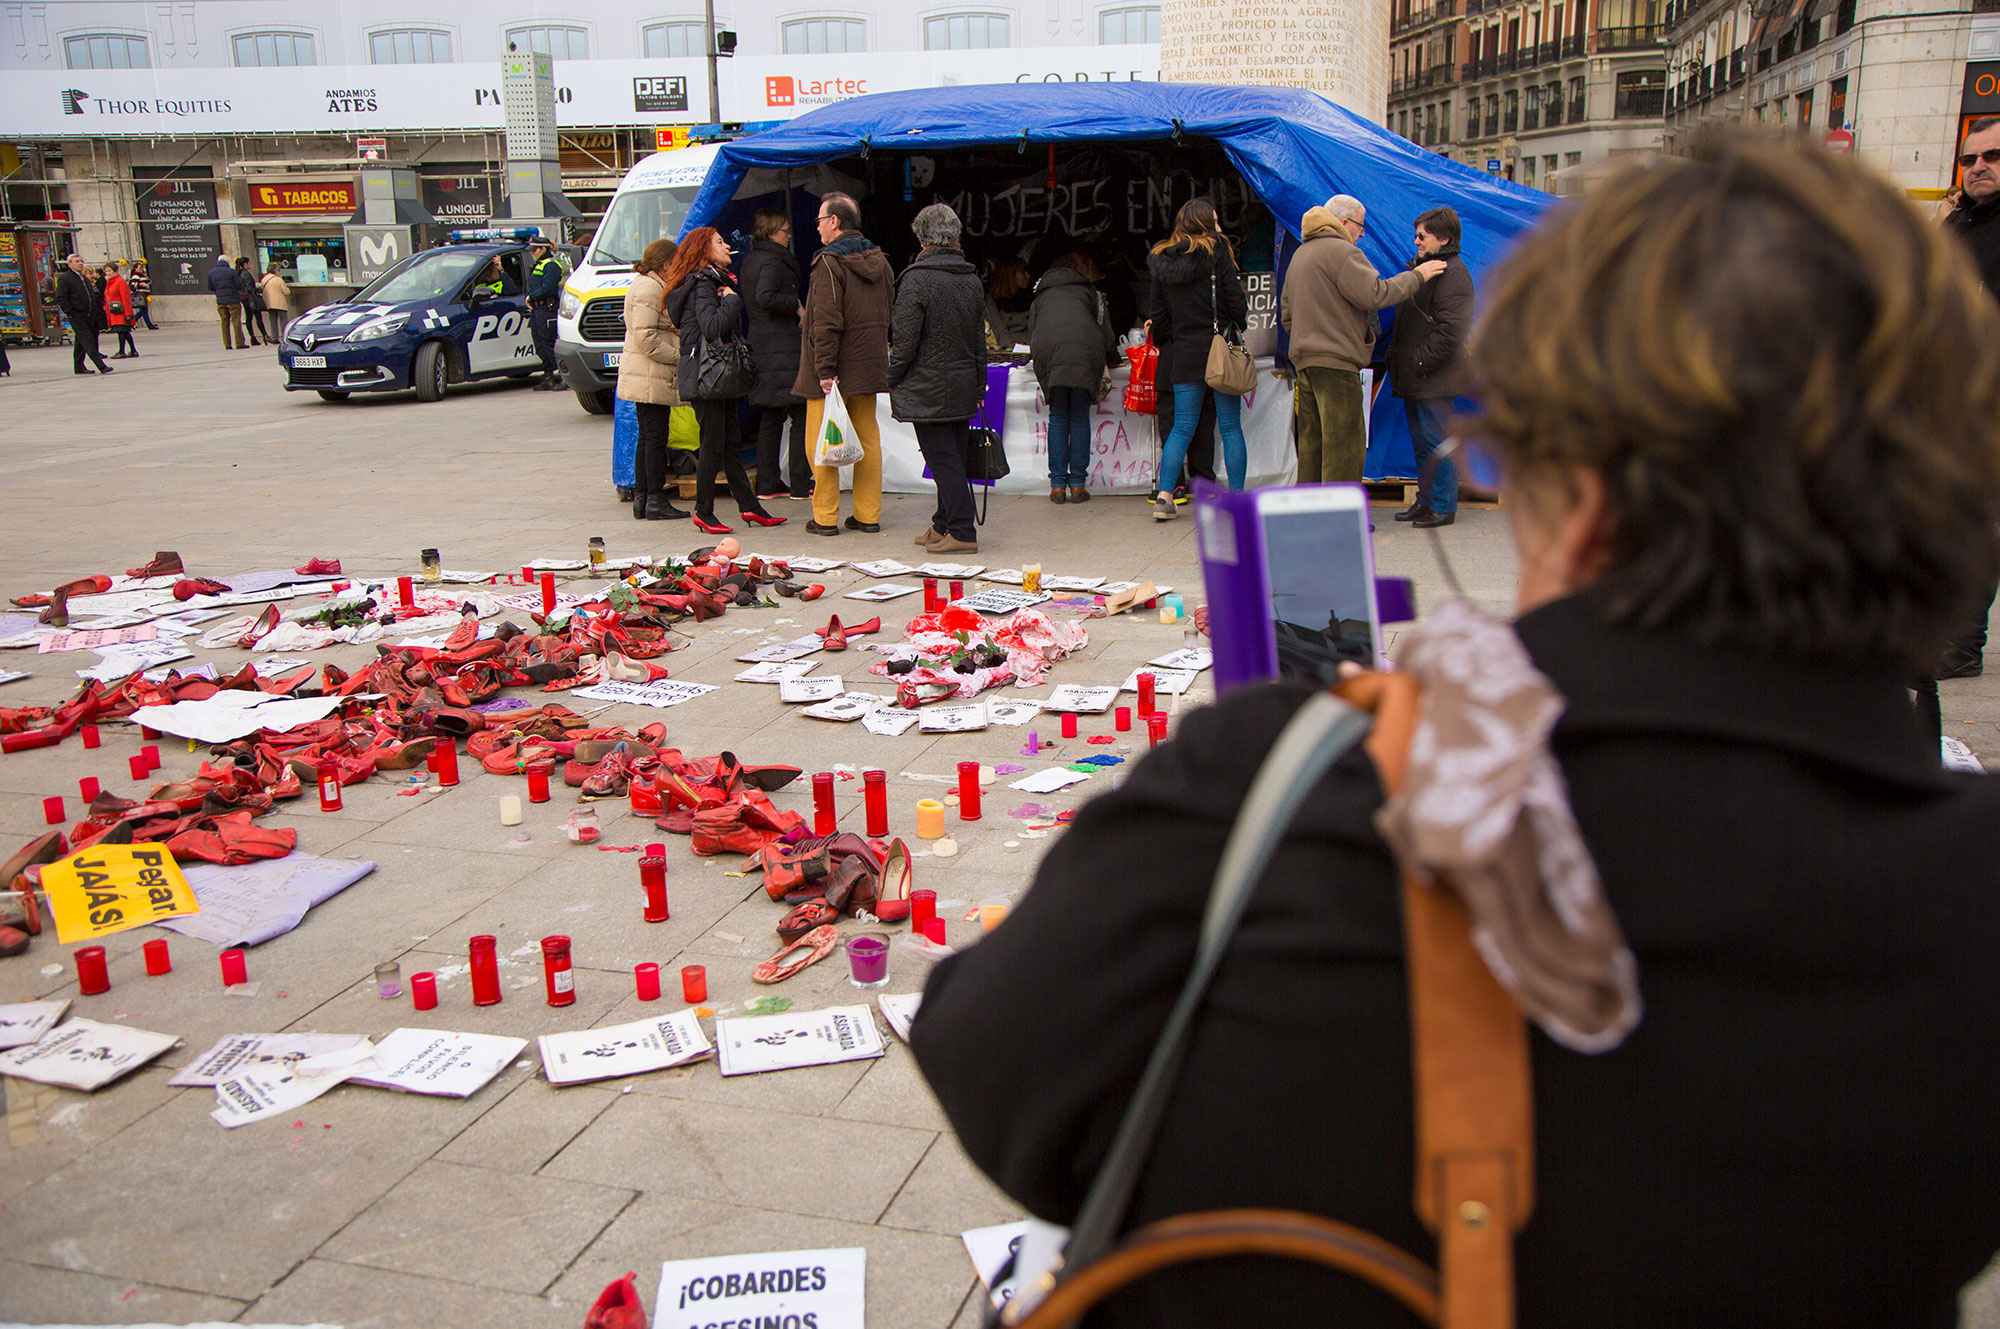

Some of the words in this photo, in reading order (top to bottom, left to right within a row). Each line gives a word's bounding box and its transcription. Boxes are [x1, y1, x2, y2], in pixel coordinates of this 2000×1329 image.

[1210, 10, 1224, 19] LA
[1232, 8, 1289, 18] REFORMA
[1297, 7, 1346, 17] AGRARIA
[1172, 22, 1213, 34] NAVALES
[1222, 19, 1277, 30] PROPICIO
[1283, 20, 1297, 28] LA
[1173, 37, 1185, 46] DE
[1191, 32, 1261, 45] MERCANCIAS
[1270, 32, 1277, 41] Y
[1192, 48, 1204, 56] DE
[1211, 43, 1273, 55] COMERCIO
[1281, 43, 1305, 51] CON
[1246, 56, 1315, 66] DESARROLLO
[1168, 68, 1232, 82] AMERICANAS
[1240, 68, 1296, 79] MEDIANTE
[1304, 68, 1315, 78] EL
[636, 78, 685, 96] DEFI
[798, 76, 867, 95] Lartec
[326, 89, 377, 98] ANDAMIOS
[94, 98, 150, 114] THOR
[155, 98, 232, 116] EQUITIES
[328, 99, 378, 113] ATES
[173, 182, 195, 194] JLL
[456, 178, 478, 190] JLL
[283, 190, 348, 204] TABACOS
[167, 206, 207, 216] UBICACIÓN
[436, 206, 444, 214] A
[446, 204, 486, 214] UNIQUE
[1127, 175, 1172, 235] EN
[1248, 274, 1271, 292] DE
[294, 357, 310, 366] 9663
[312, 356, 326, 366] HXP
[426, 1044, 472, 1082] SILENCIO
[679, 1266, 827, 1310] ¡COBARDES
